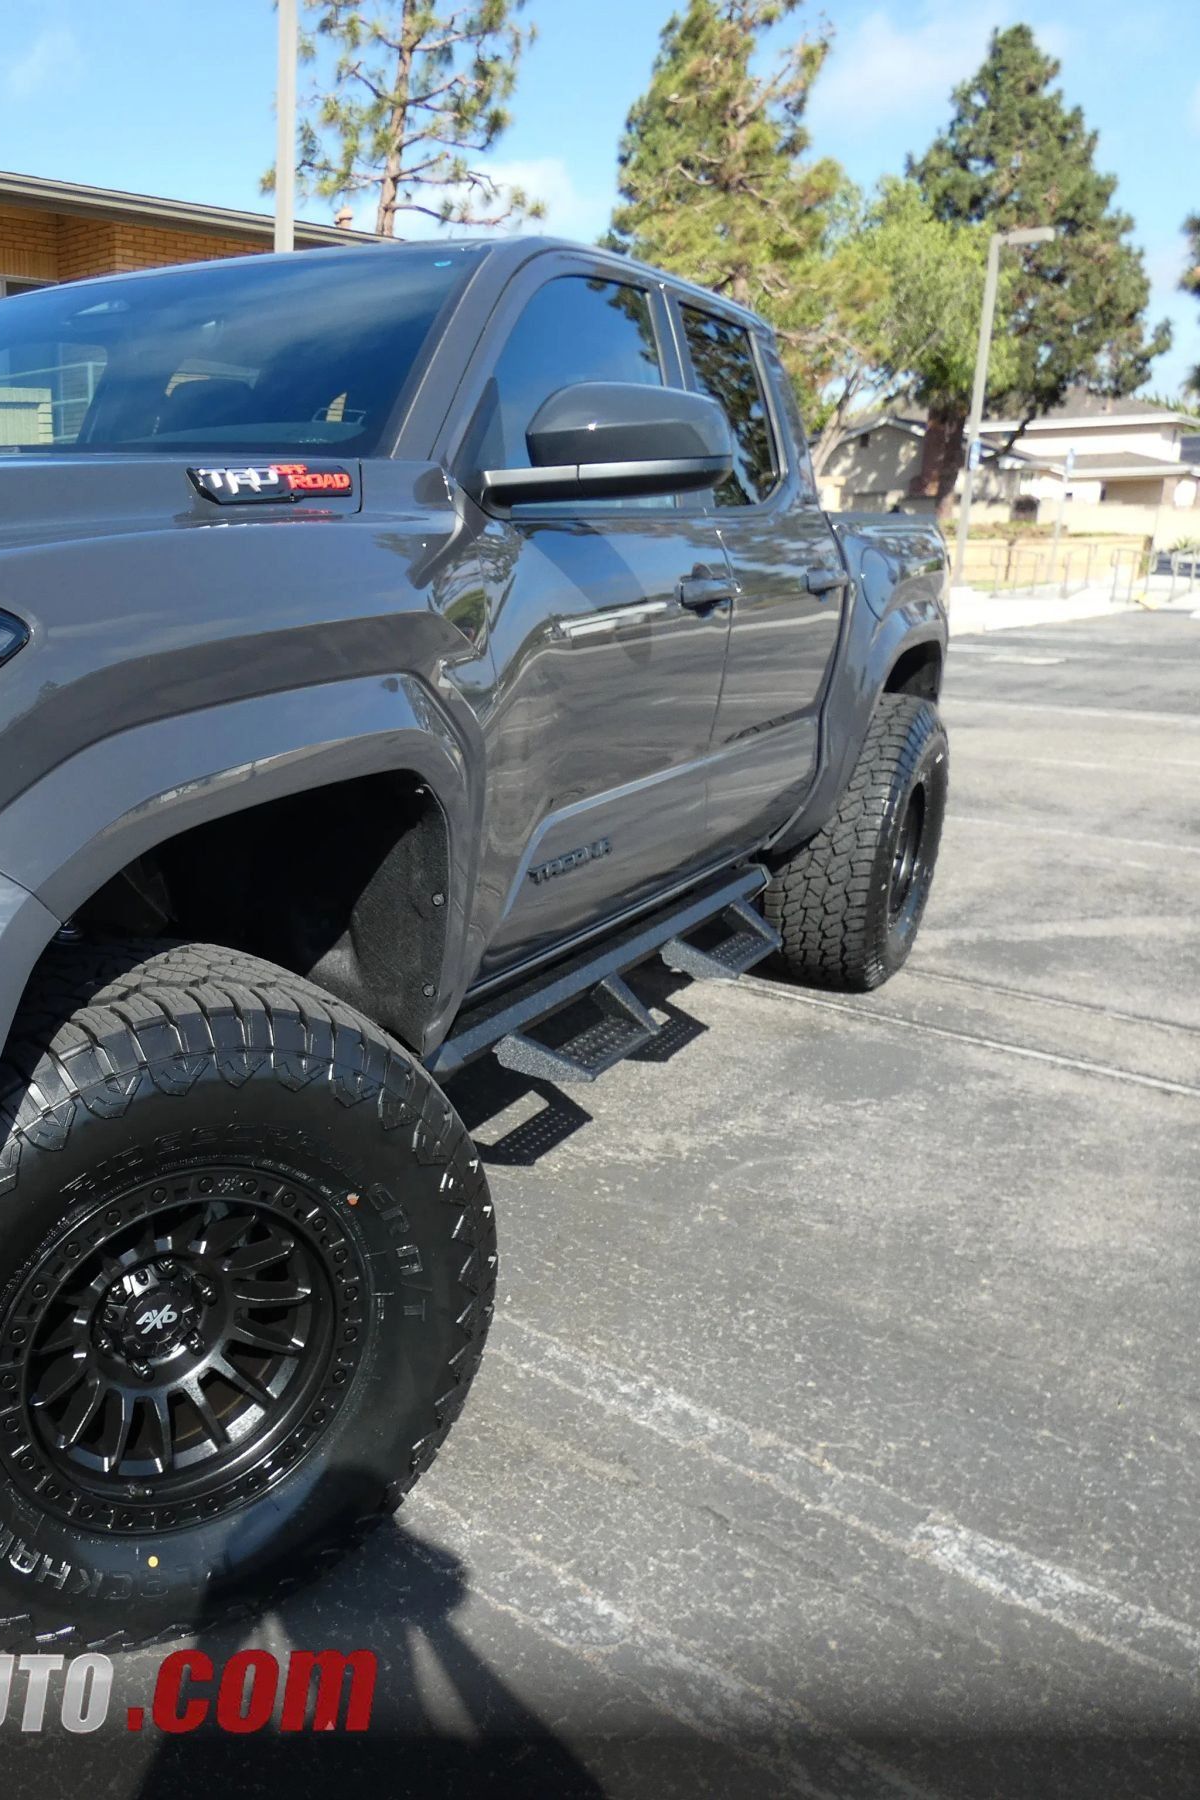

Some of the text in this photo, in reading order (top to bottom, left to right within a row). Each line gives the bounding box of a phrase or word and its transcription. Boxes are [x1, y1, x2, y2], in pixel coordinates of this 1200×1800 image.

[199, 466, 280, 495] TRD
[269, 463, 307, 475] OFF
[287, 473, 350, 490] ROAD
[527, 837, 612, 886] TACOMA
